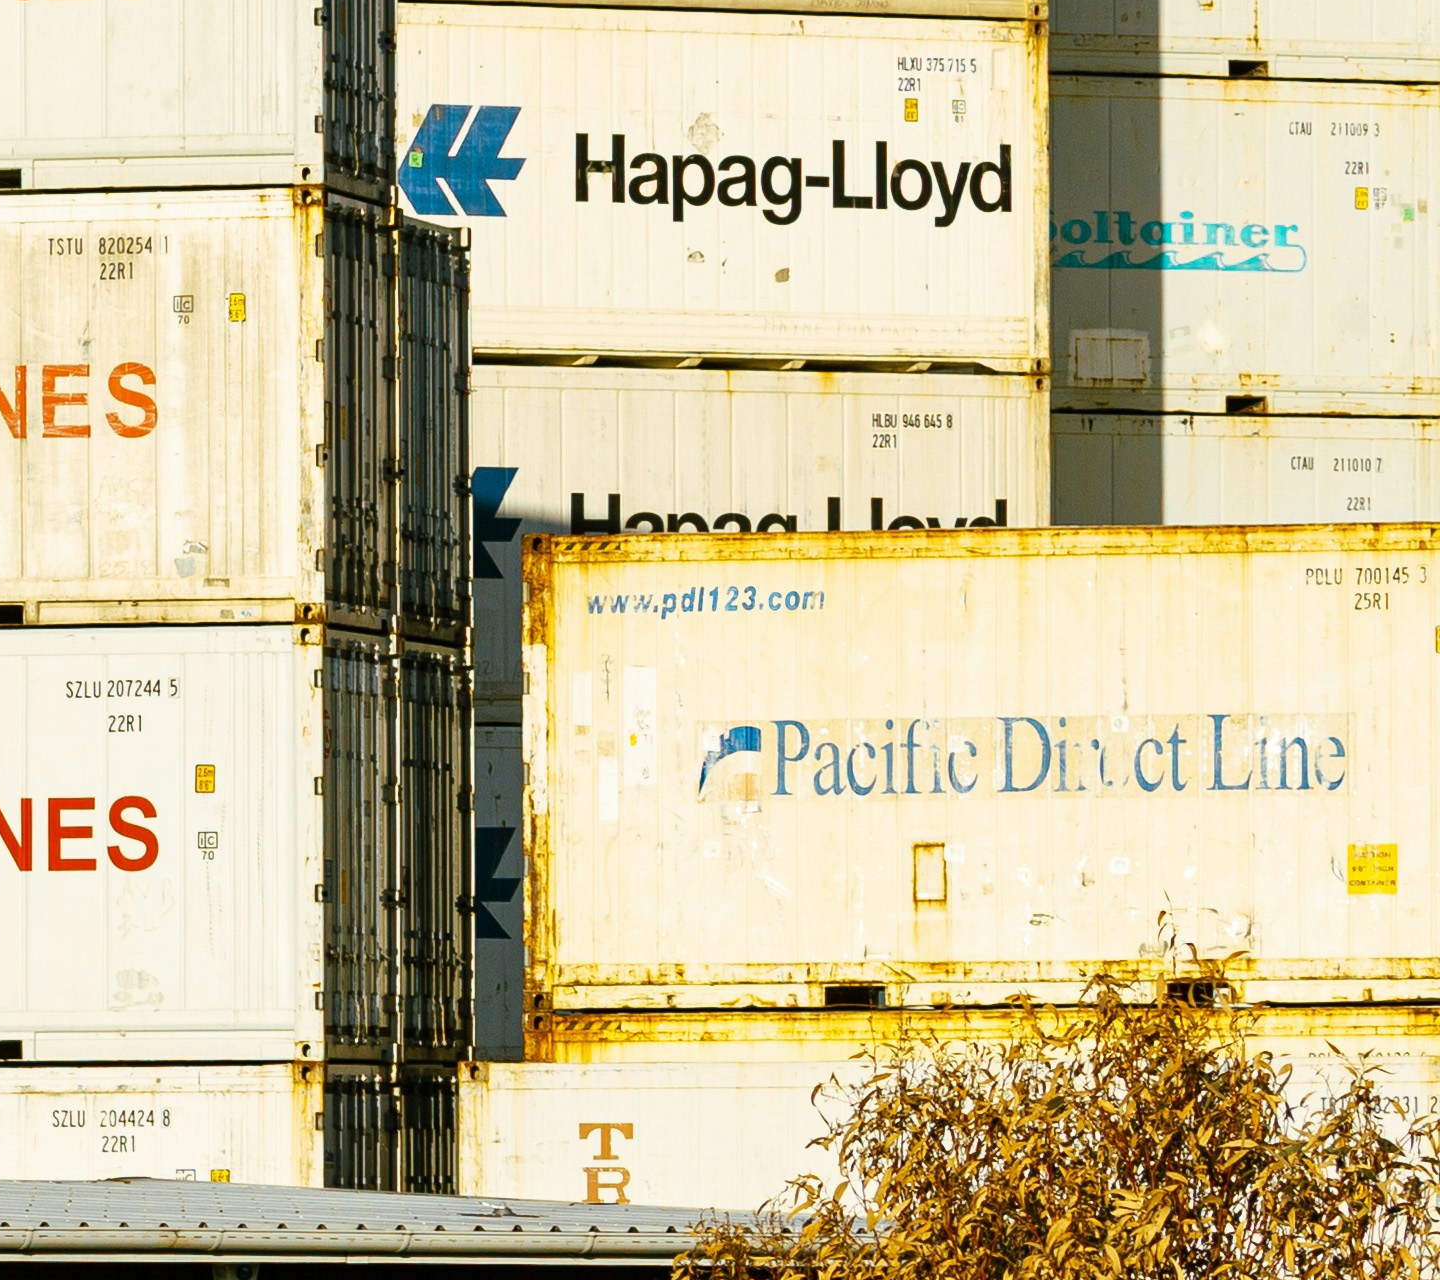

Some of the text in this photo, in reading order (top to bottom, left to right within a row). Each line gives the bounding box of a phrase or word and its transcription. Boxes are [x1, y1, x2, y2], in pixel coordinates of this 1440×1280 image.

[575, 132, 1013, 228] Hapag-Lloyd
[1291, 457, 1382, 473] CTAU 211010 7
[1347, 497, 1371, 511] 22R1
[1305, 566, 1427, 586] PDLU 700145 3
[587, 586, 825, 620] www.pdl123.com
[1354, 593, 1390, 611] 25R1
[65, 677, 179, 700] SZLU 207244 5
[107, 713, 143, 734] 22R1
[772, 713, 1347, 797] Pacific Dirct Line
[52, 1108, 172, 1130] SZLU 204424 8
[101, 1134, 136, 1155] 22R1
